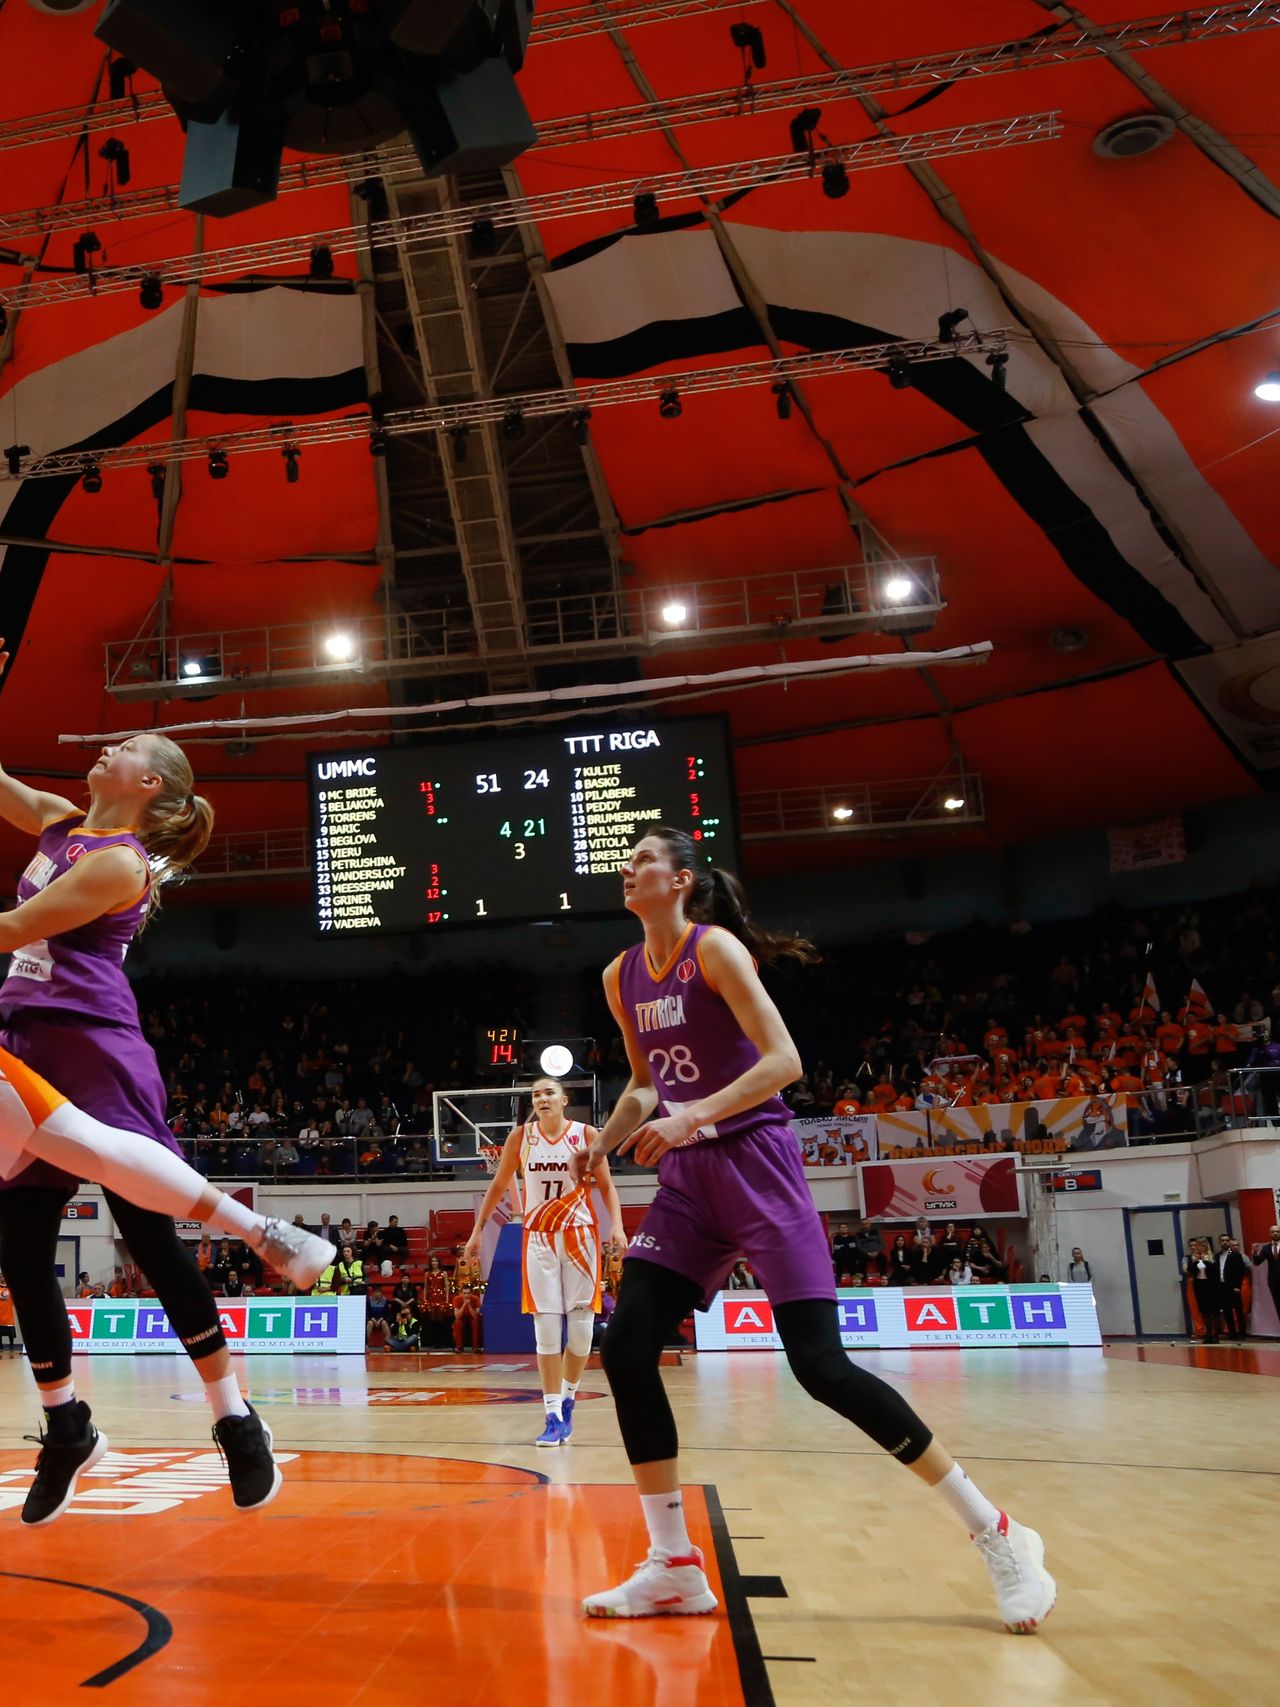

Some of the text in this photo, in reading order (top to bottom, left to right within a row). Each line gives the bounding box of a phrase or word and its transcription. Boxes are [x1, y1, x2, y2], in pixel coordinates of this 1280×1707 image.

[564, 730, 660, 754] TTT RIGA
[318, 758, 376, 779] UMMC
[574, 757, 695, 778] 7 KULITE 7
[476, 769, 550, 793] 51 24
[574, 770, 696, 790] 8 BASKO 2
[319, 782, 433, 801] 0 MC BRIDE 11
[571, 787, 636, 802] 10 PILABERE
[320, 794, 434, 813] 5 BELIAKOVA 3
[572, 793, 698, 814] 11 PEDDY 5
[320, 806, 435, 825] 7 TORRENS 3
[572, 805, 699, 826] 13 BRUMERMANE 2
[321, 823, 360, 836] 9 BARIC
[500, 818, 545, 838] 4 21
[574, 824, 635, 838] 15 PULVERE
[316, 834, 376, 848] 13 BEGLOVA
[574, 840, 587, 850] 28
[589, 837, 628, 849] VITOLA
[317, 847, 361, 860] 15 VIERU
[514, 842, 526, 859] 3
[575, 848, 634, 863] 35 KRESLIN
[317, 856, 396, 871] 21 PETRUSHINA
[575, 865, 589, 875] 44
[318, 864, 438, 883] 22 VANDERSLOOT 3
[318, 876, 439, 895] 33 MEESSEMAN 2
[318, 888, 439, 906] 42 GRINER 12
[559, 892, 571, 910] 1
[319, 905, 374, 918] 44 MUSINA
[475, 898, 487, 916] 1
[319, 912, 440, 930] 77 VADEEVA 17
[491, 1045, 512, 1063] 14
[649, 1044, 700, 1086] 28
[528, 1163, 568, 1172] UMM
[541, 1181, 563, 1200] 77
[629, 1232, 661, 1251] ts.
[924, 1333, 1053, 1342] ТЕЛЕКОМПАНИЯ
